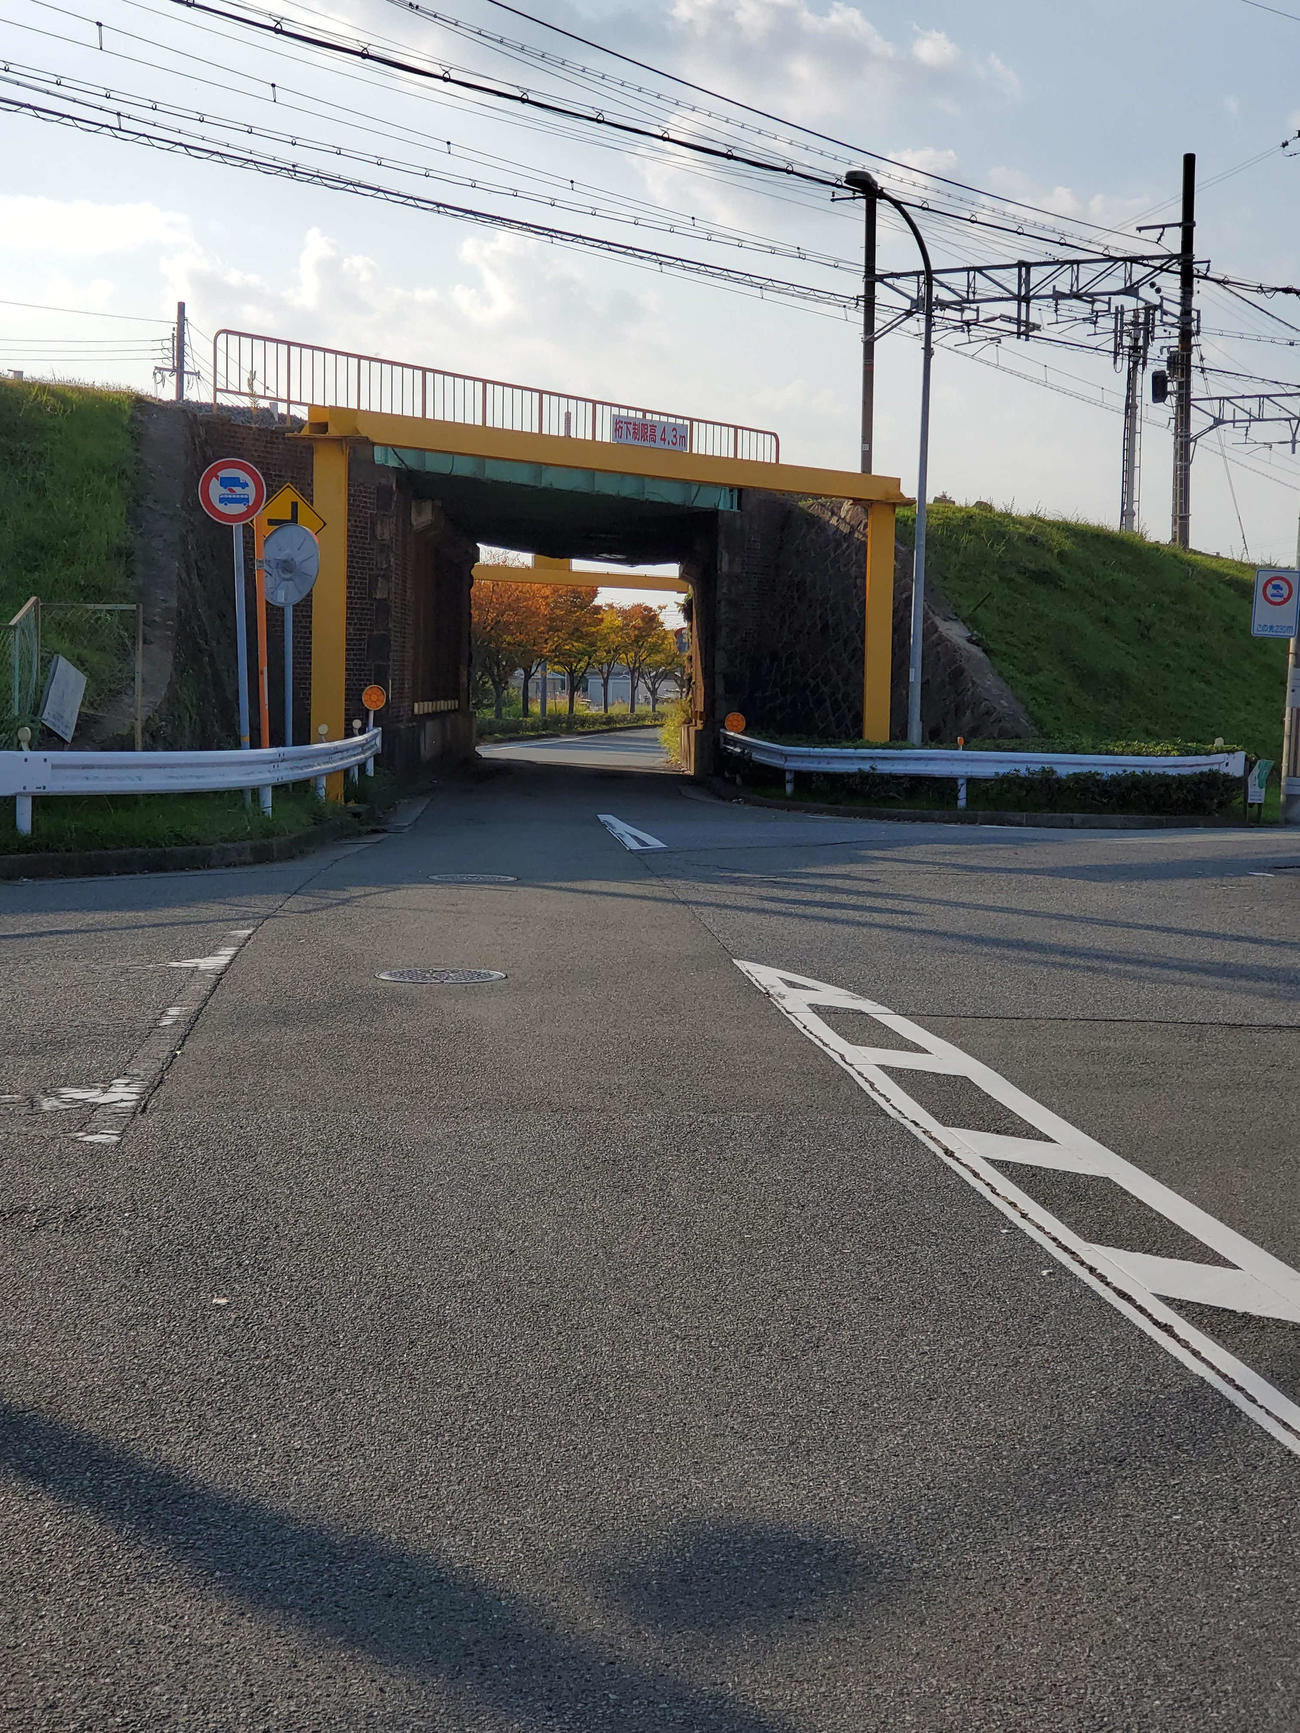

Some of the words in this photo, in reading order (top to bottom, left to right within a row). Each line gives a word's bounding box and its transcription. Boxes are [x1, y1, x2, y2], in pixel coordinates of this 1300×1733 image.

[615, 419, 656, 443] 桁下制限高
[660, 426, 685, 447] 4.3m
